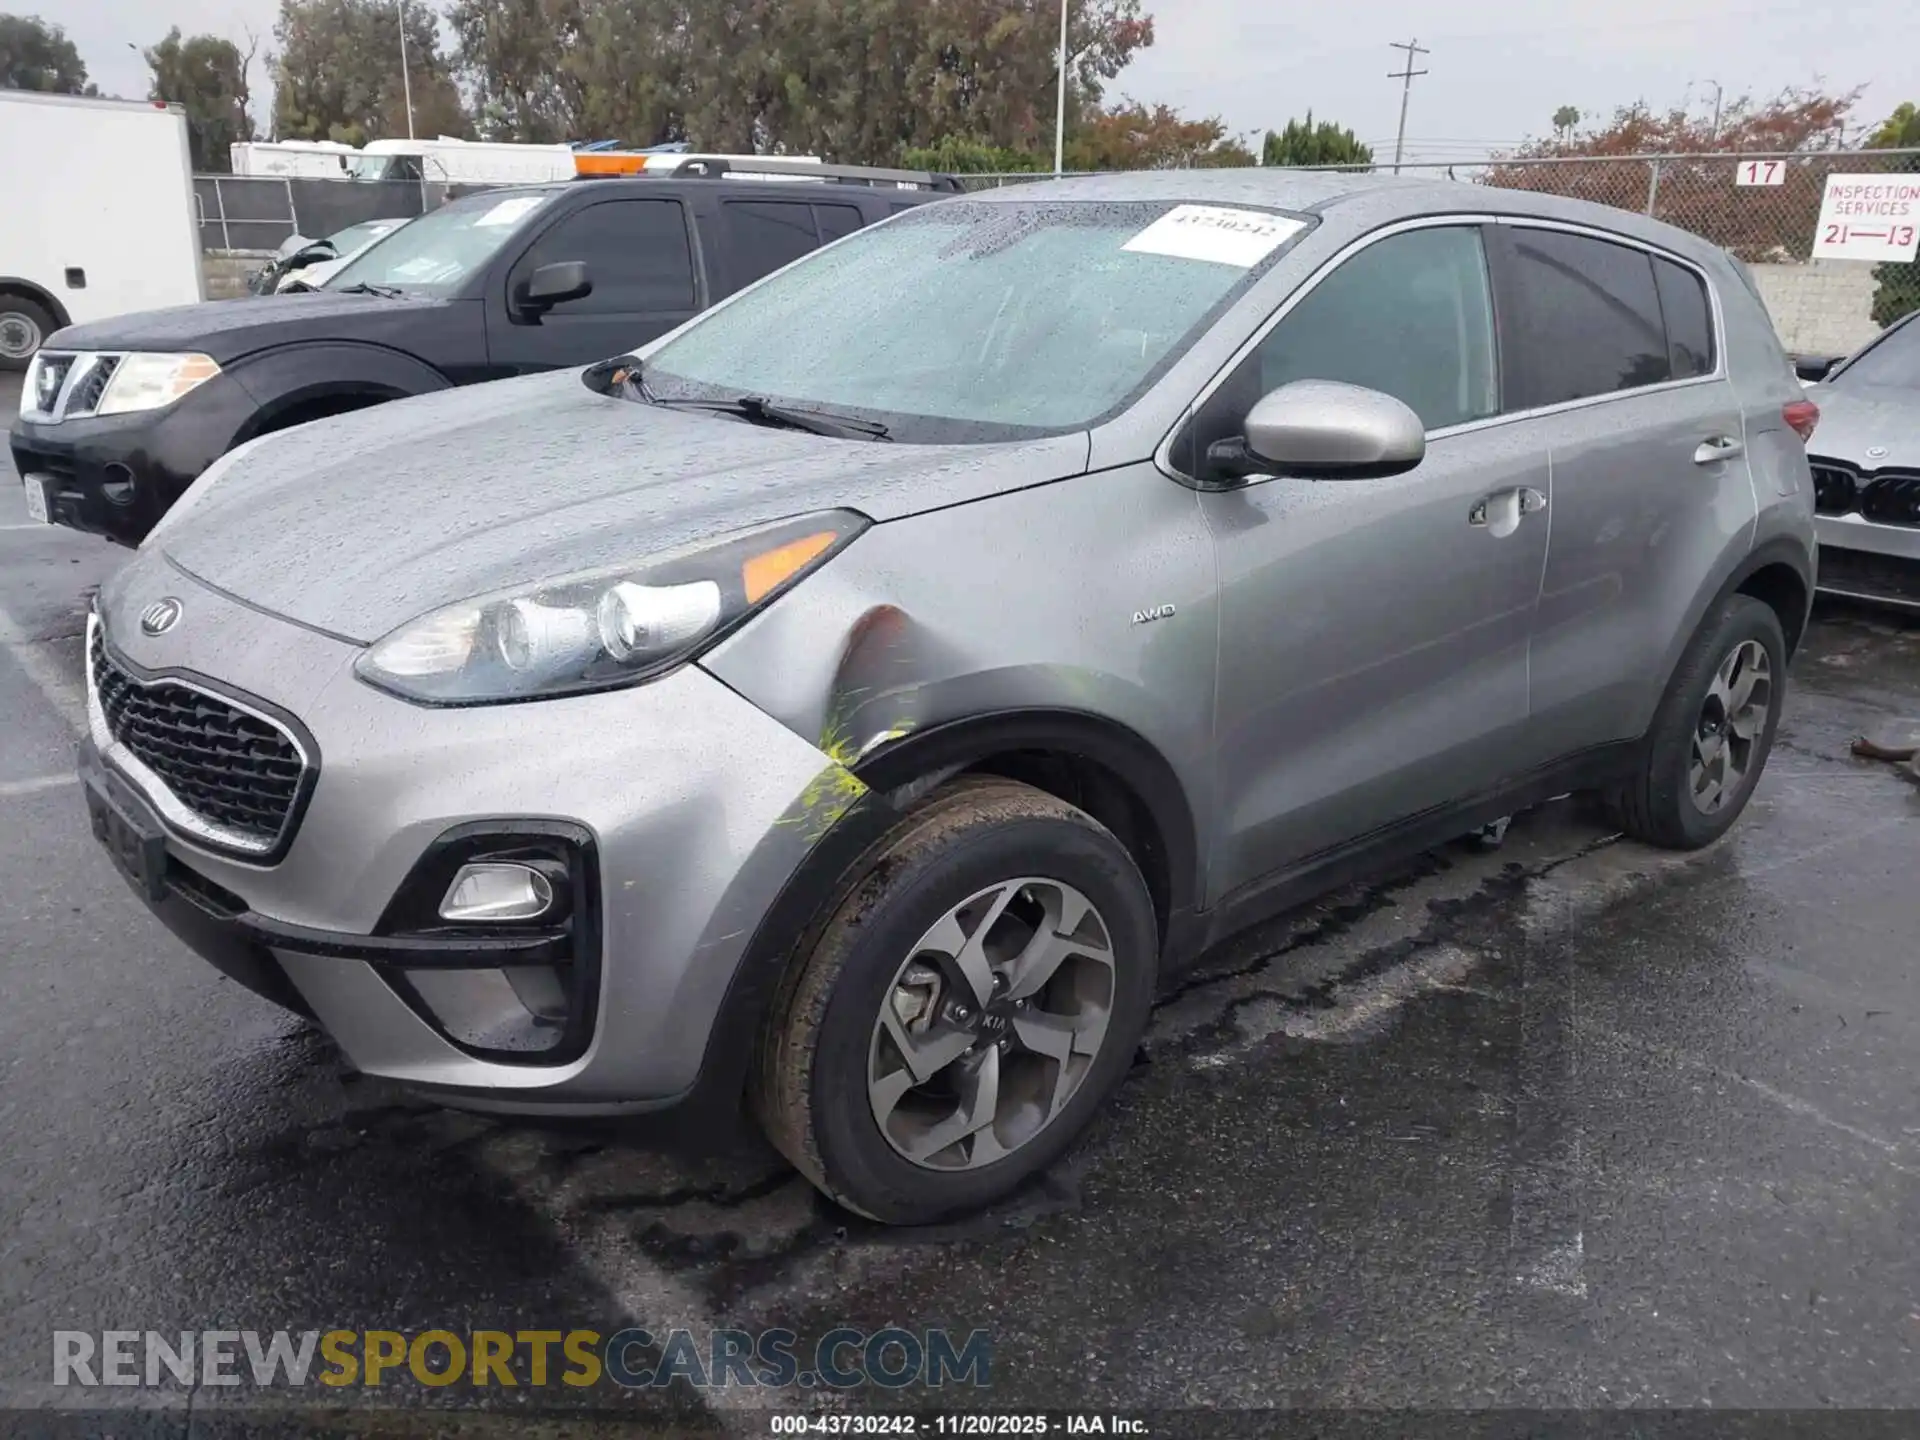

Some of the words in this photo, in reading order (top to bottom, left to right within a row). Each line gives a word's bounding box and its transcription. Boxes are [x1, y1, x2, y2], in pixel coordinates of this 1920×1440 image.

[1747, 162, 1778, 183] 17
[1829, 185, 1920, 199] INSPECTION
[1834, 202, 1910, 215] SERVICES
[1132, 604, 1176, 624] AWD
[982, 1014, 1006, 1030] KIA
